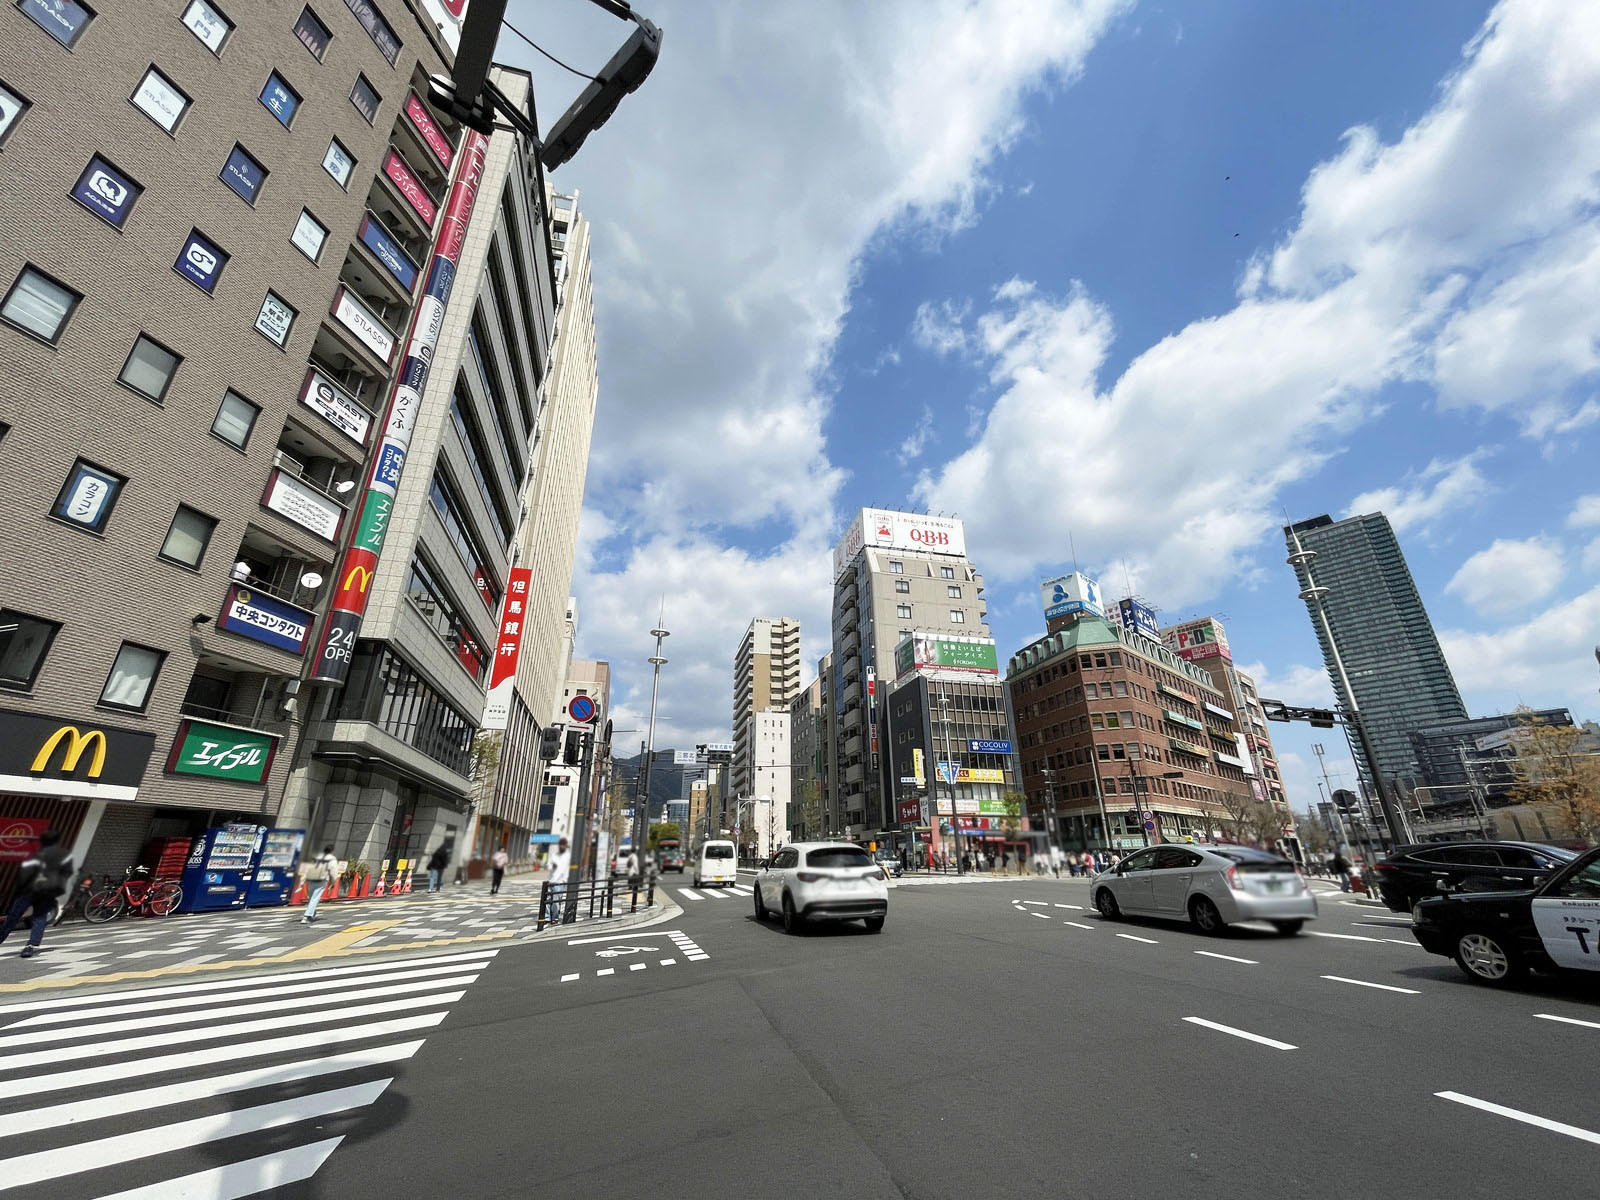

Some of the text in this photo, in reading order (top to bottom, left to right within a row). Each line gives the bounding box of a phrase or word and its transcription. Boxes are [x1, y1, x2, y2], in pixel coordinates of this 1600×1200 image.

[268, 86, 287, 115] 再生
[229, 164, 255, 190] STLASSH
[262, 311, 286, 331] クリニック
[267, 299, 290, 319] イースト
[429, 305, 442, 336] STLASSH
[354, 313, 388, 349] STLASSH
[337, 397, 365, 420] EAST
[381, 448, 393, 479] コンタクト
[389, 453, 404, 482] 中央
[76, 482, 99, 516] カラコン
[368, 499, 391, 546] エイブル
[235, 605, 303, 638] 中央コンタクト
[500, 580, 526, 657] 但馬銀行
[327, 627, 357, 652] 24
[193, 741, 262, 770] エイブル
[979, 741, 1008, 749] COCOLIV
[1566, 926, 1600, 954] T
